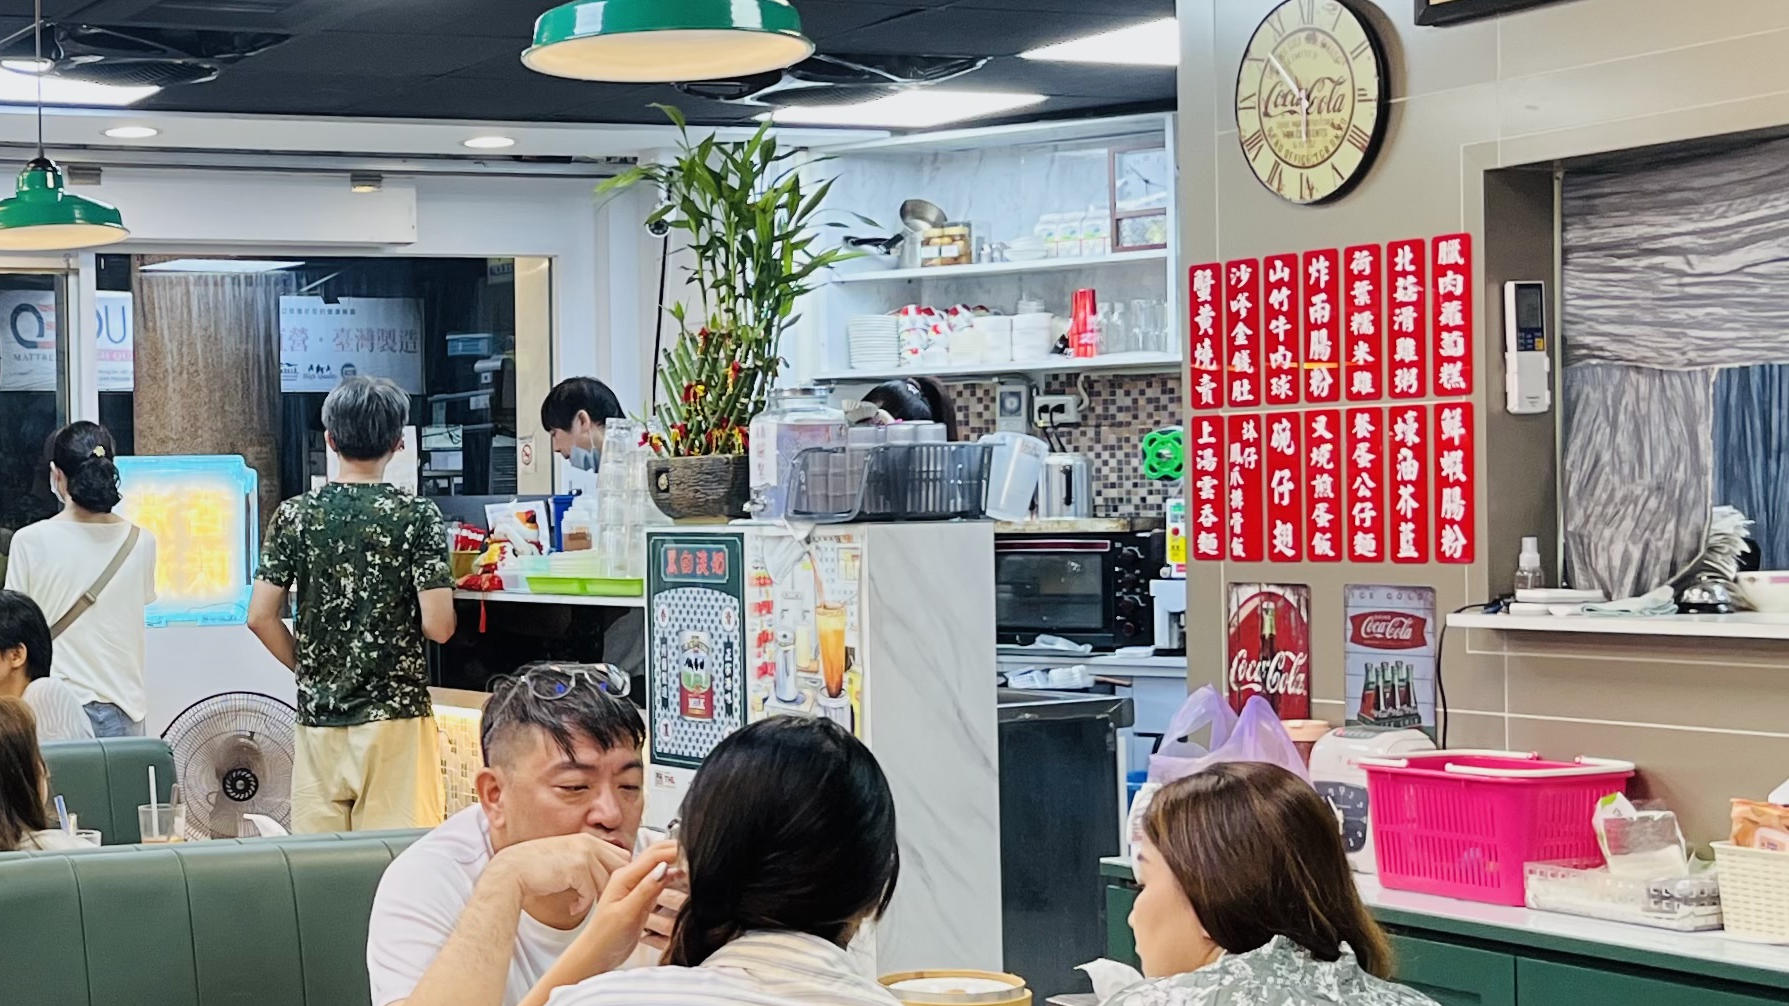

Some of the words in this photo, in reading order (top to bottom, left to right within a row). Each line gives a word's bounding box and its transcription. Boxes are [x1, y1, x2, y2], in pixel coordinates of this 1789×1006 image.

[1268, 259, 1293, 399] 山竹牛肉球
[1350, 250, 1375, 395] 荷葉糯米雞
[1393, 245, 1418, 393] 北菇滑雞粥
[1196, 421, 1219, 556] 上湯雲吞麵
[1270, 418, 1296, 557] 碗仔翅
[1440, 407, 1467, 559] 鮮蝦腸粉
[1229, 649, 1307, 696] Coca-Cola
[1361, 616, 1413, 639] Coca-Cola
